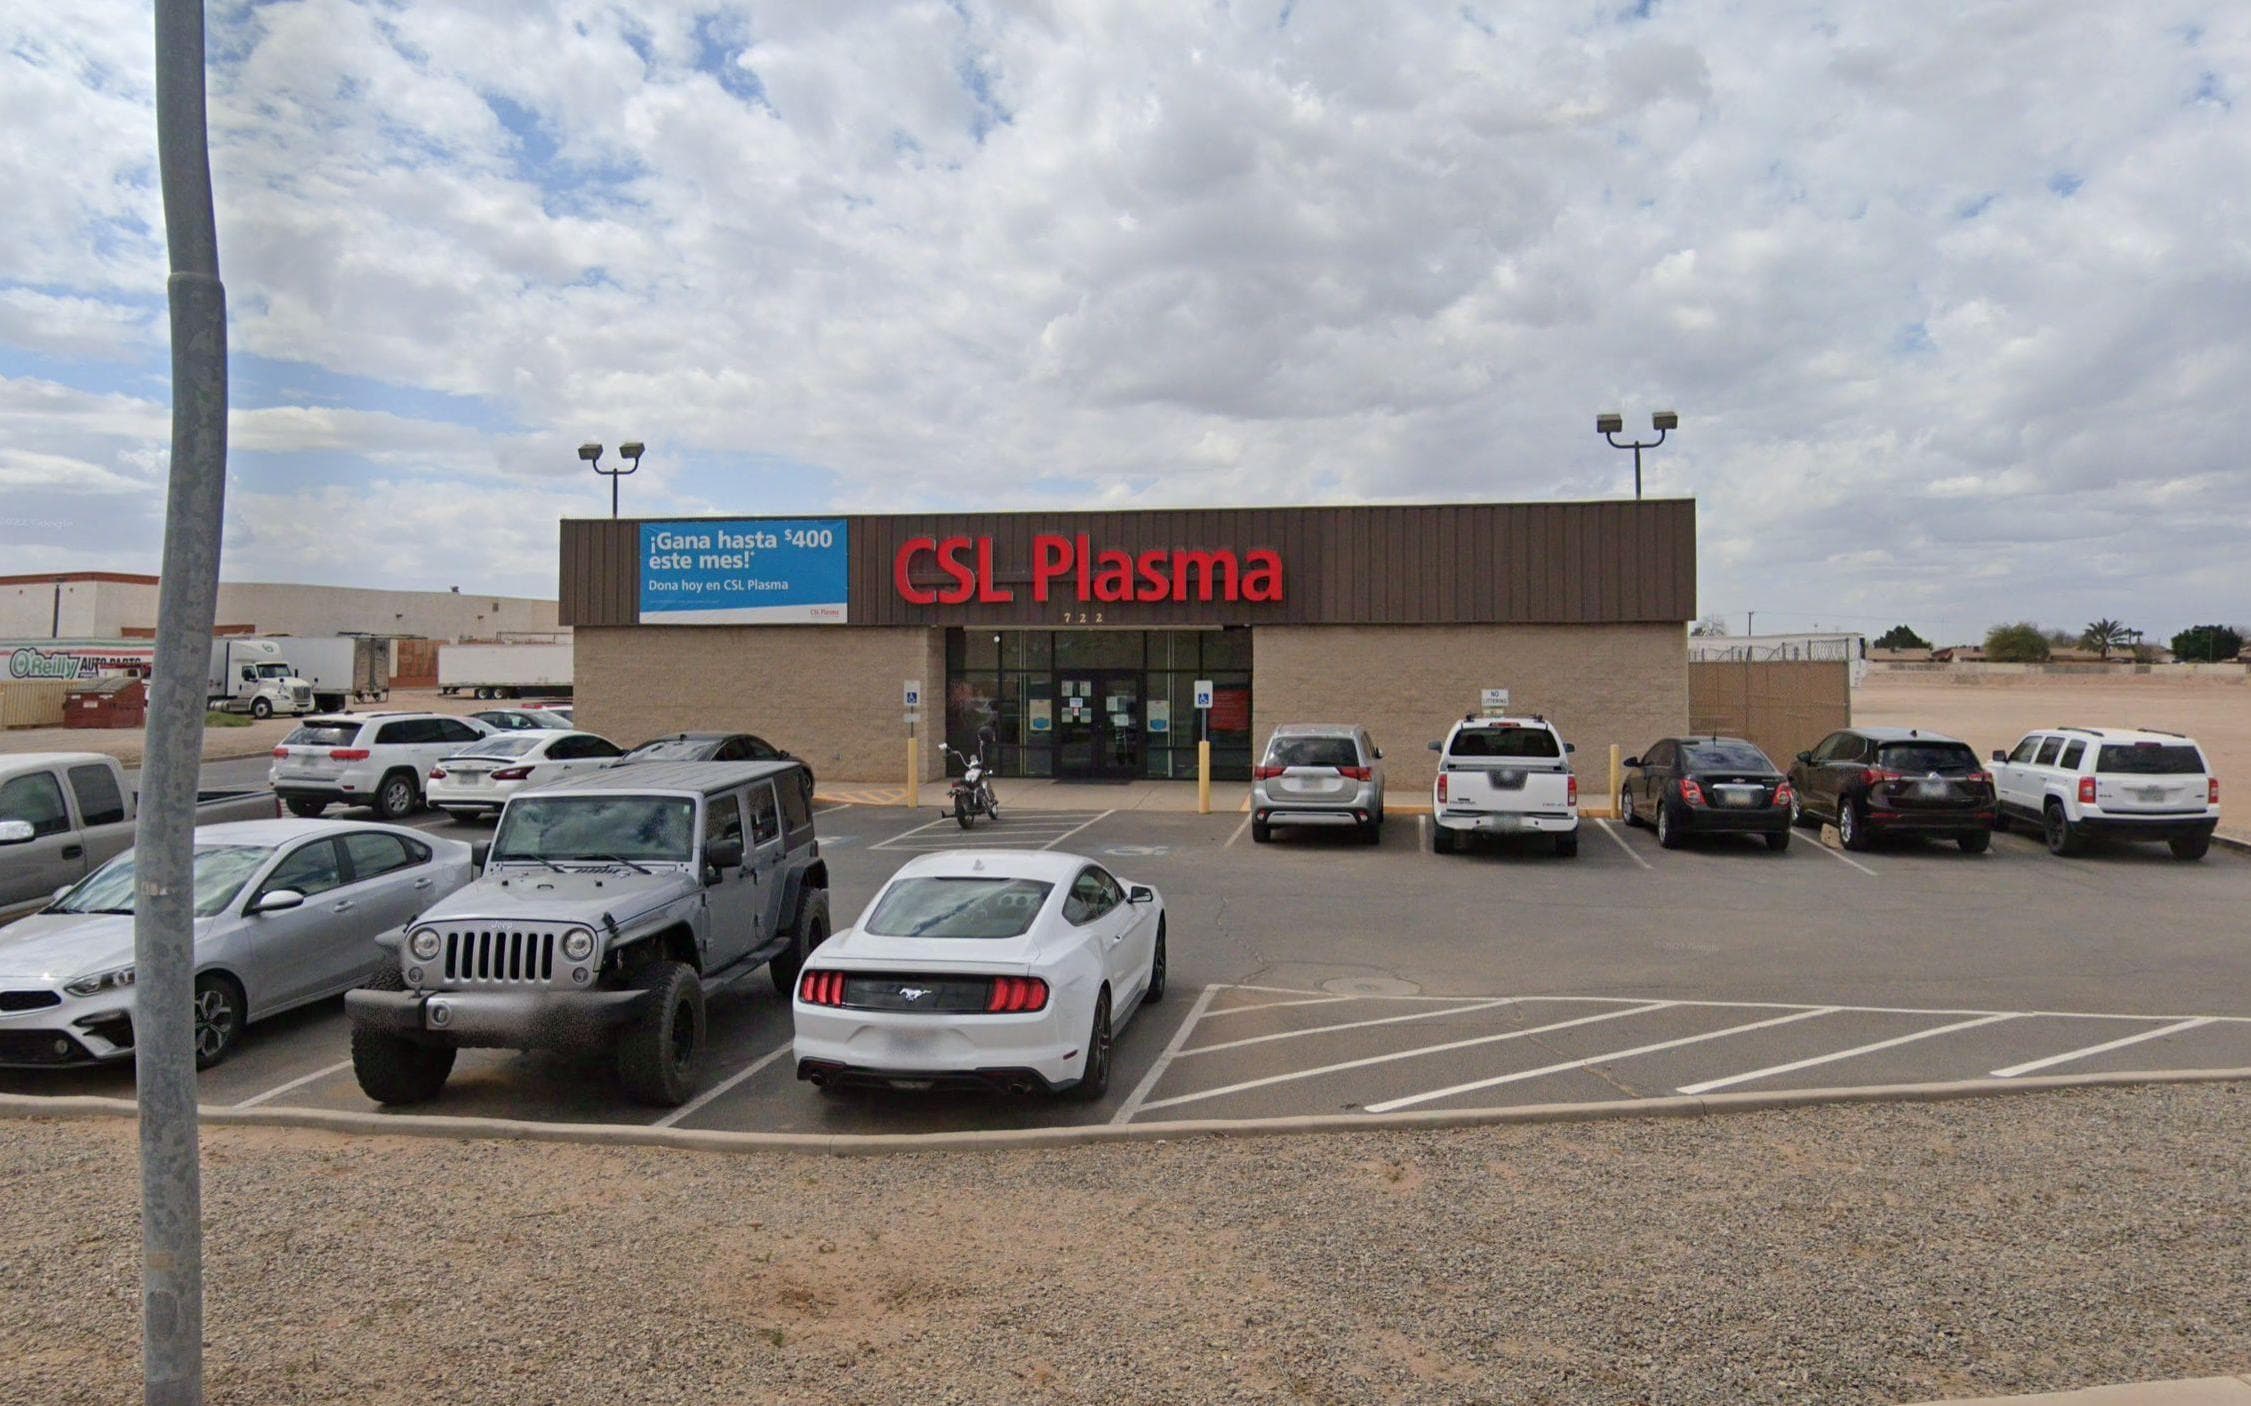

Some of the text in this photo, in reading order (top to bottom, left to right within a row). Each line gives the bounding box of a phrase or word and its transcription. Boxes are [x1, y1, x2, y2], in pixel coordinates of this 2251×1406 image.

[650, 528, 833, 554] ¡Gana hasta $400
[649, 552, 692, 569] este
[894, 533, 1284, 604] CSL Plasma
[649, 579, 789, 593] Dona hoy en CSL Plasma
[11, 648, 79, 679] O'Reilly
